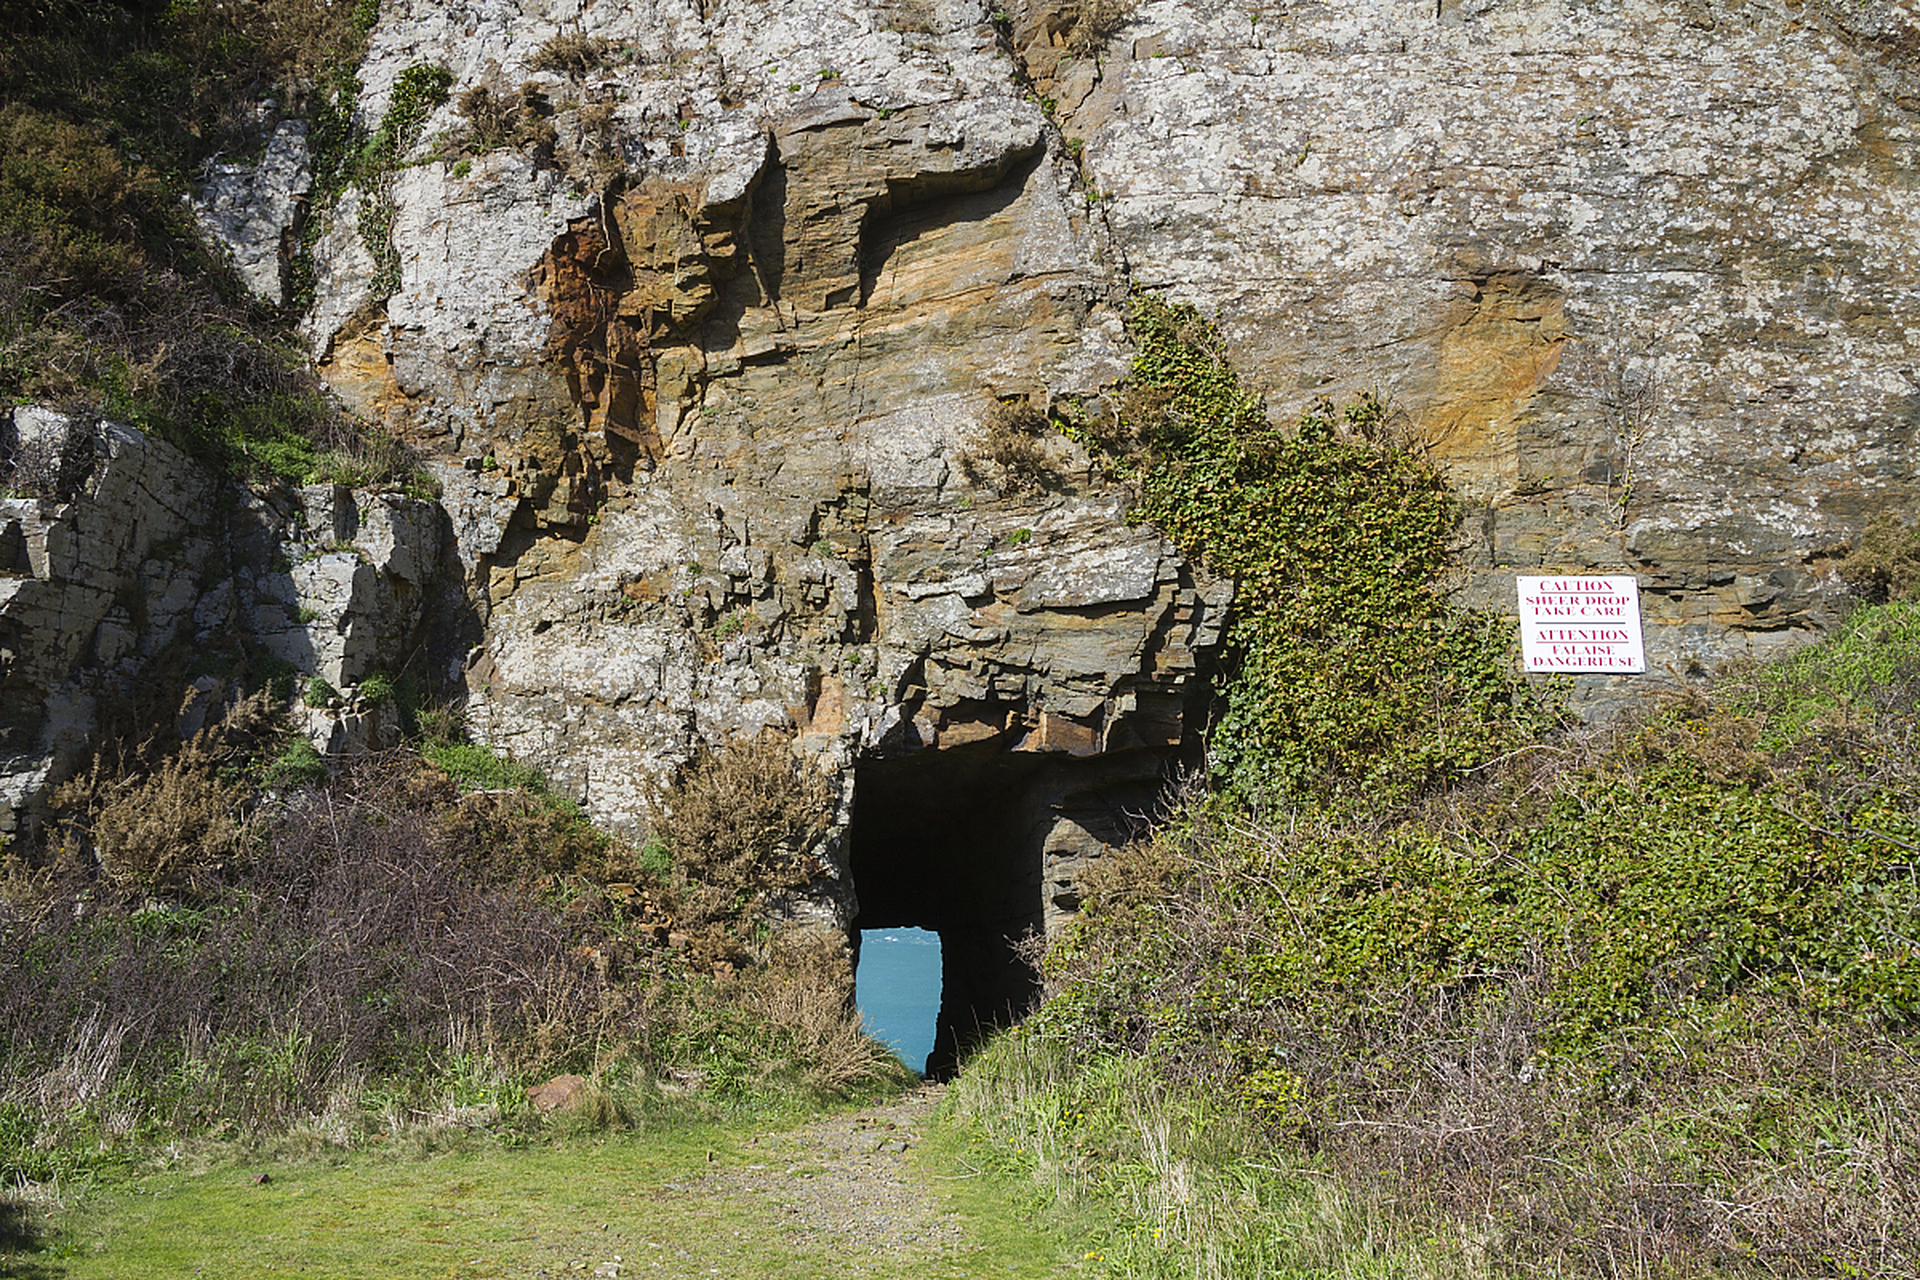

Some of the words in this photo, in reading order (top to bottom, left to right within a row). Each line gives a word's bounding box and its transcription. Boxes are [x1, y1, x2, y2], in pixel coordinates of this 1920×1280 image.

[1540, 580, 1613, 591] CAUTION
[1526, 596, 1580, 605] SHEER
[1586, 596, 1630, 605] DROP
[1531, 606, 1576, 616] TAKE
[1580, 606, 1626, 616] CARE
[1536, 629, 1628, 640] ATTENTION
[1553, 645, 1616, 655] FALAISE
[1533, 656, 1636, 667] DANGEREUSE
